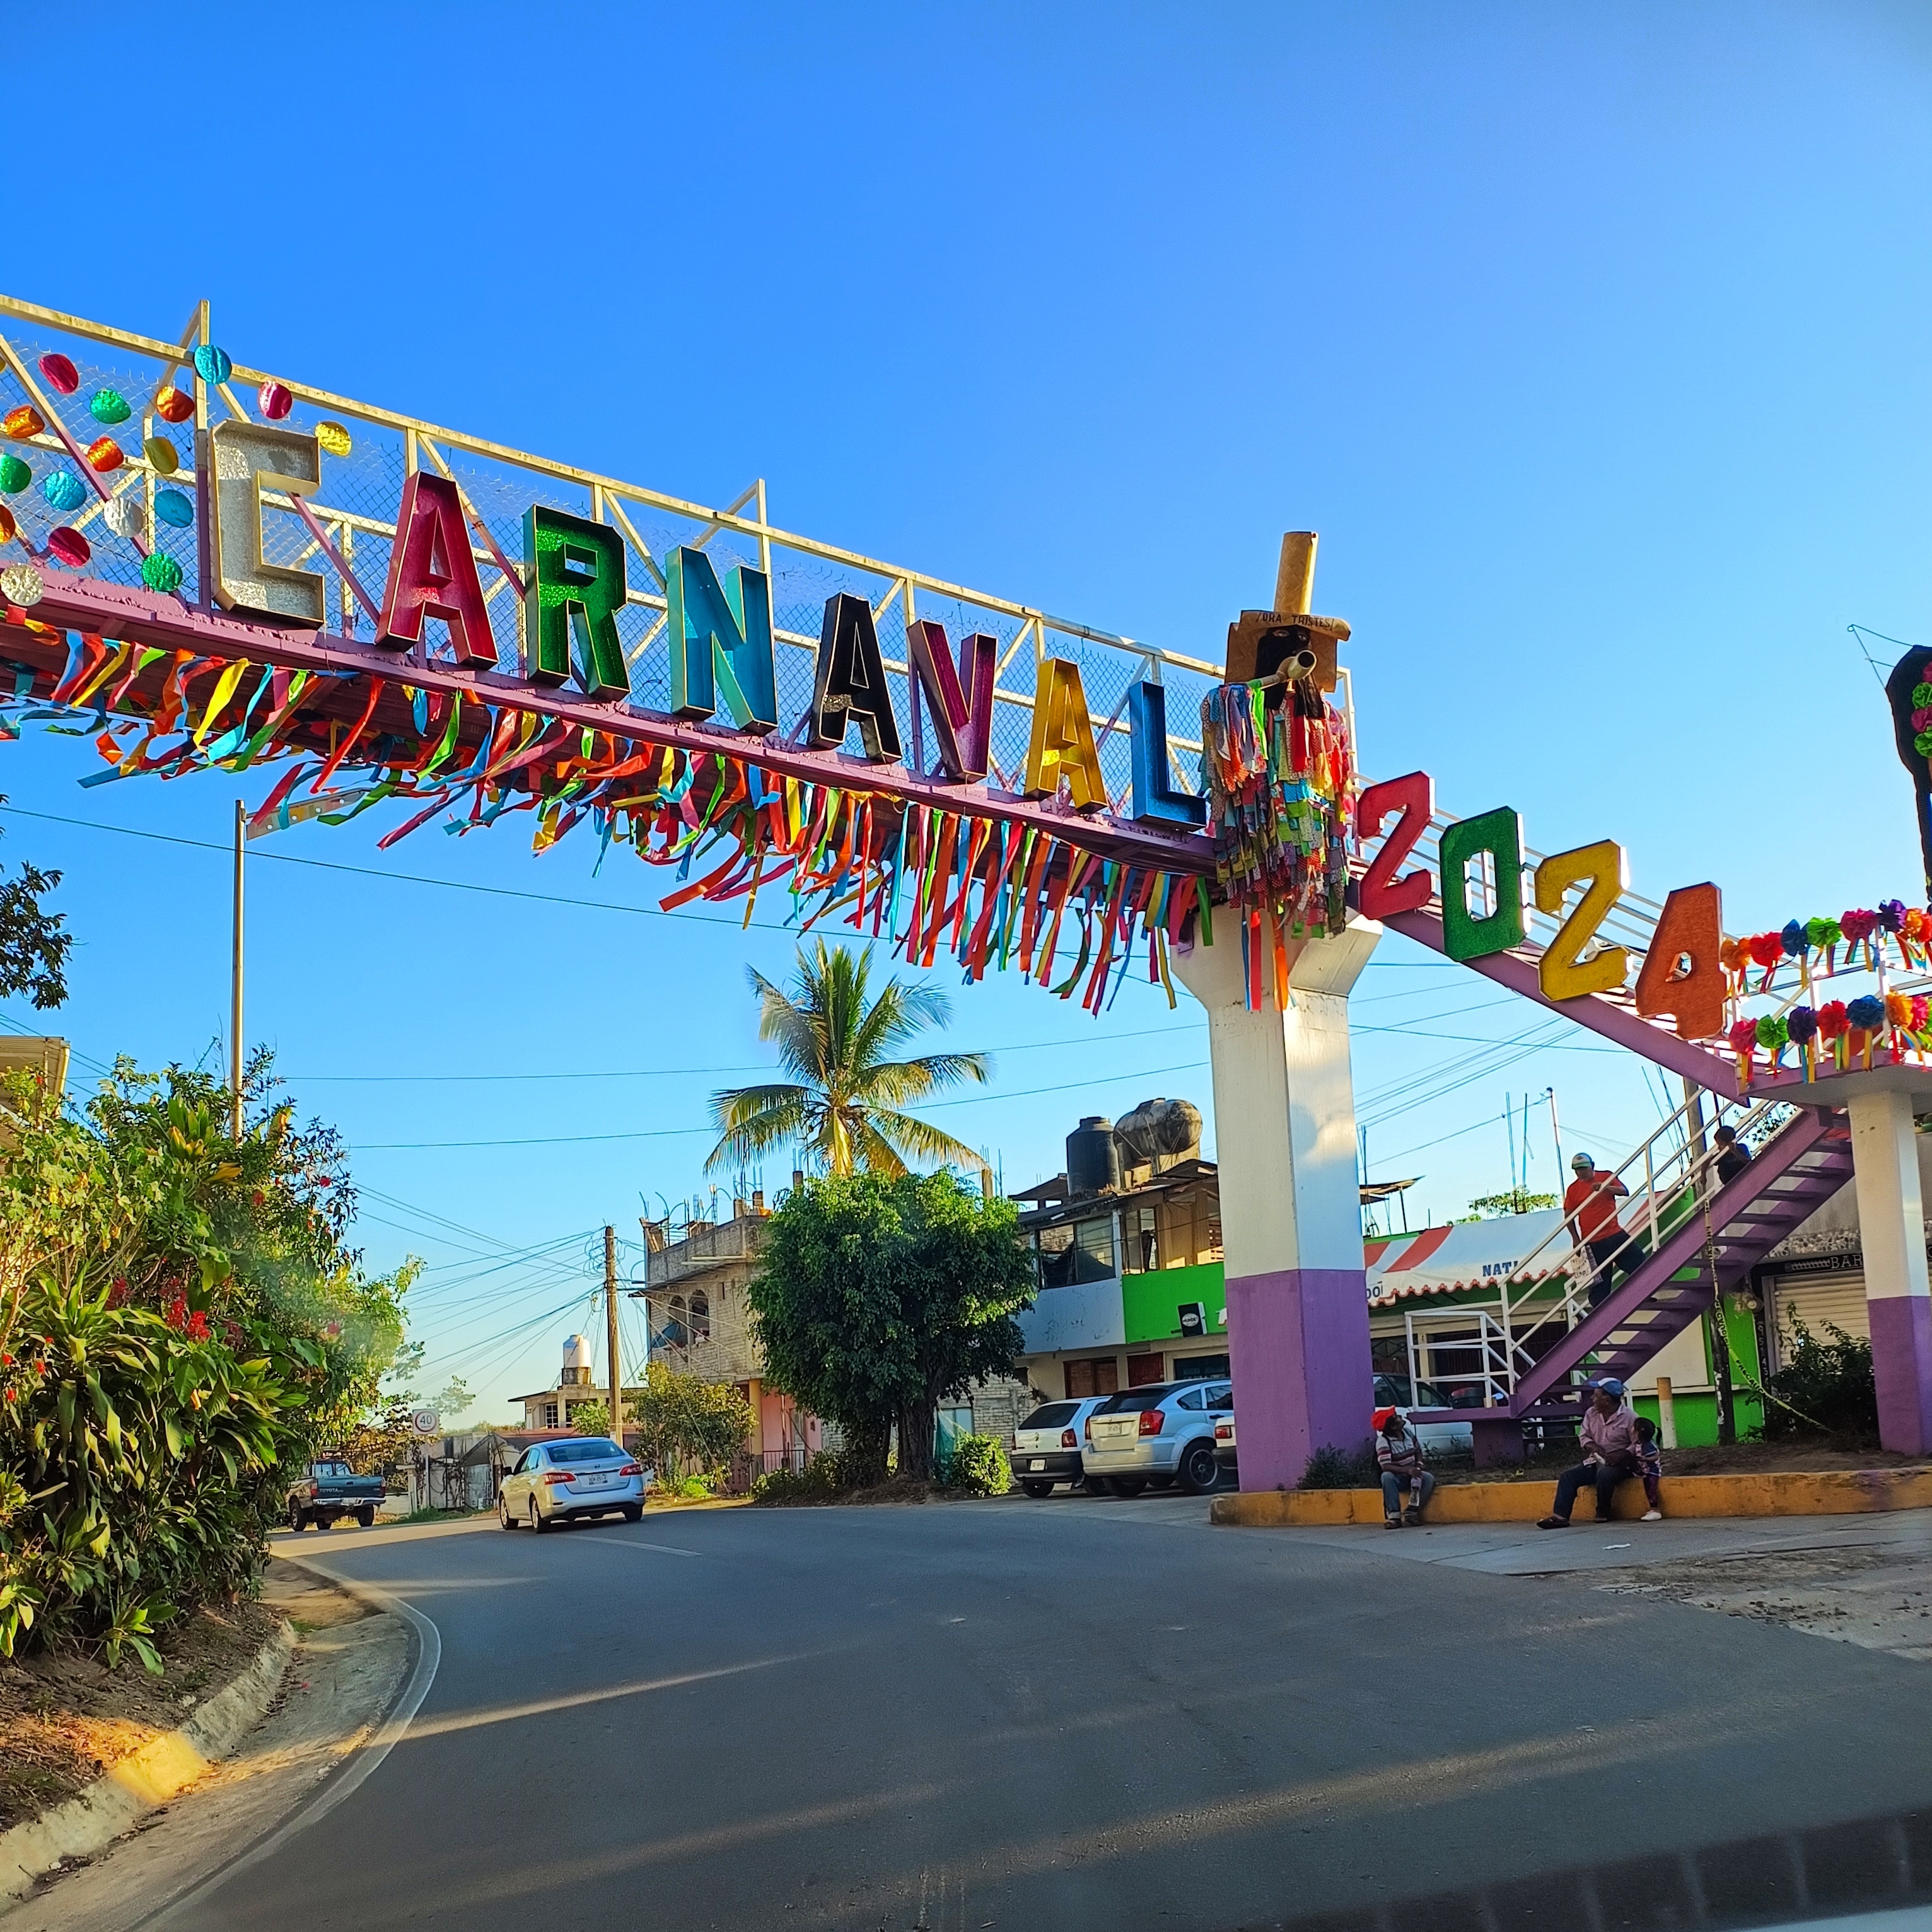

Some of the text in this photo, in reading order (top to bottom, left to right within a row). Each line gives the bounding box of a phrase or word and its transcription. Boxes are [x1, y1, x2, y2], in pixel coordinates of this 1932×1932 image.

[211, 419, 1726, 1040] CARNAVAL 2024
[420, 1414, 432, 1424] 40
